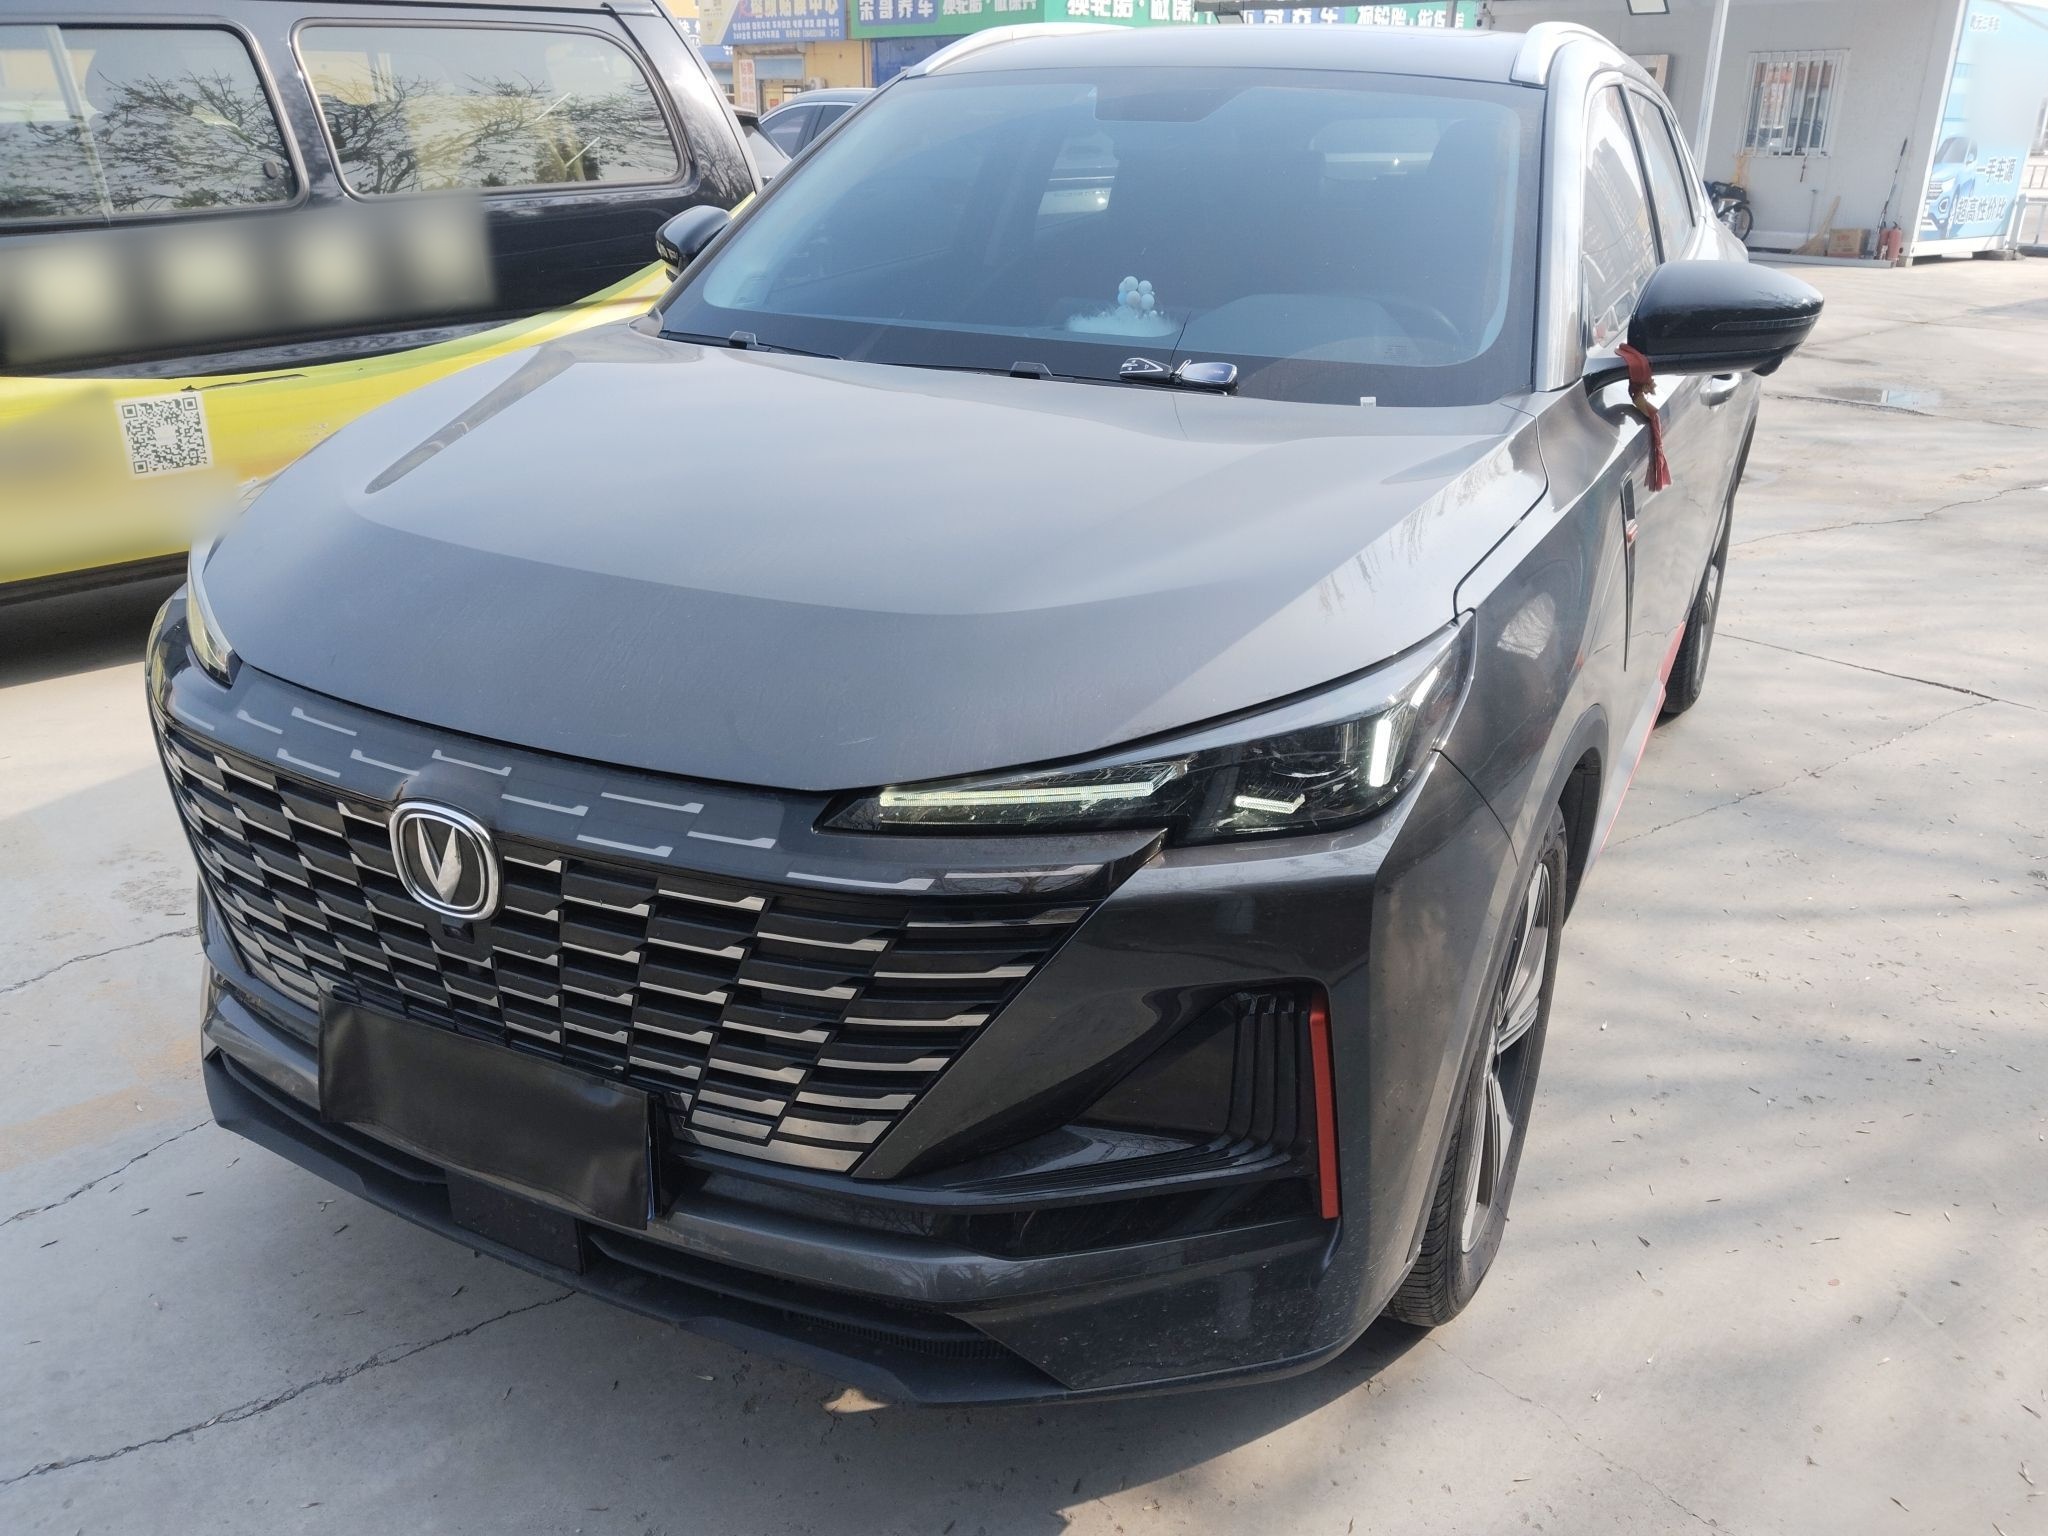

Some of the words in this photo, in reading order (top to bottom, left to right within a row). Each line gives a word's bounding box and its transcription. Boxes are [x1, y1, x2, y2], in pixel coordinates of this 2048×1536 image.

[1976, 157, 2017, 183] 一手车源
[1956, 196, 2007, 223] 超高性价比
